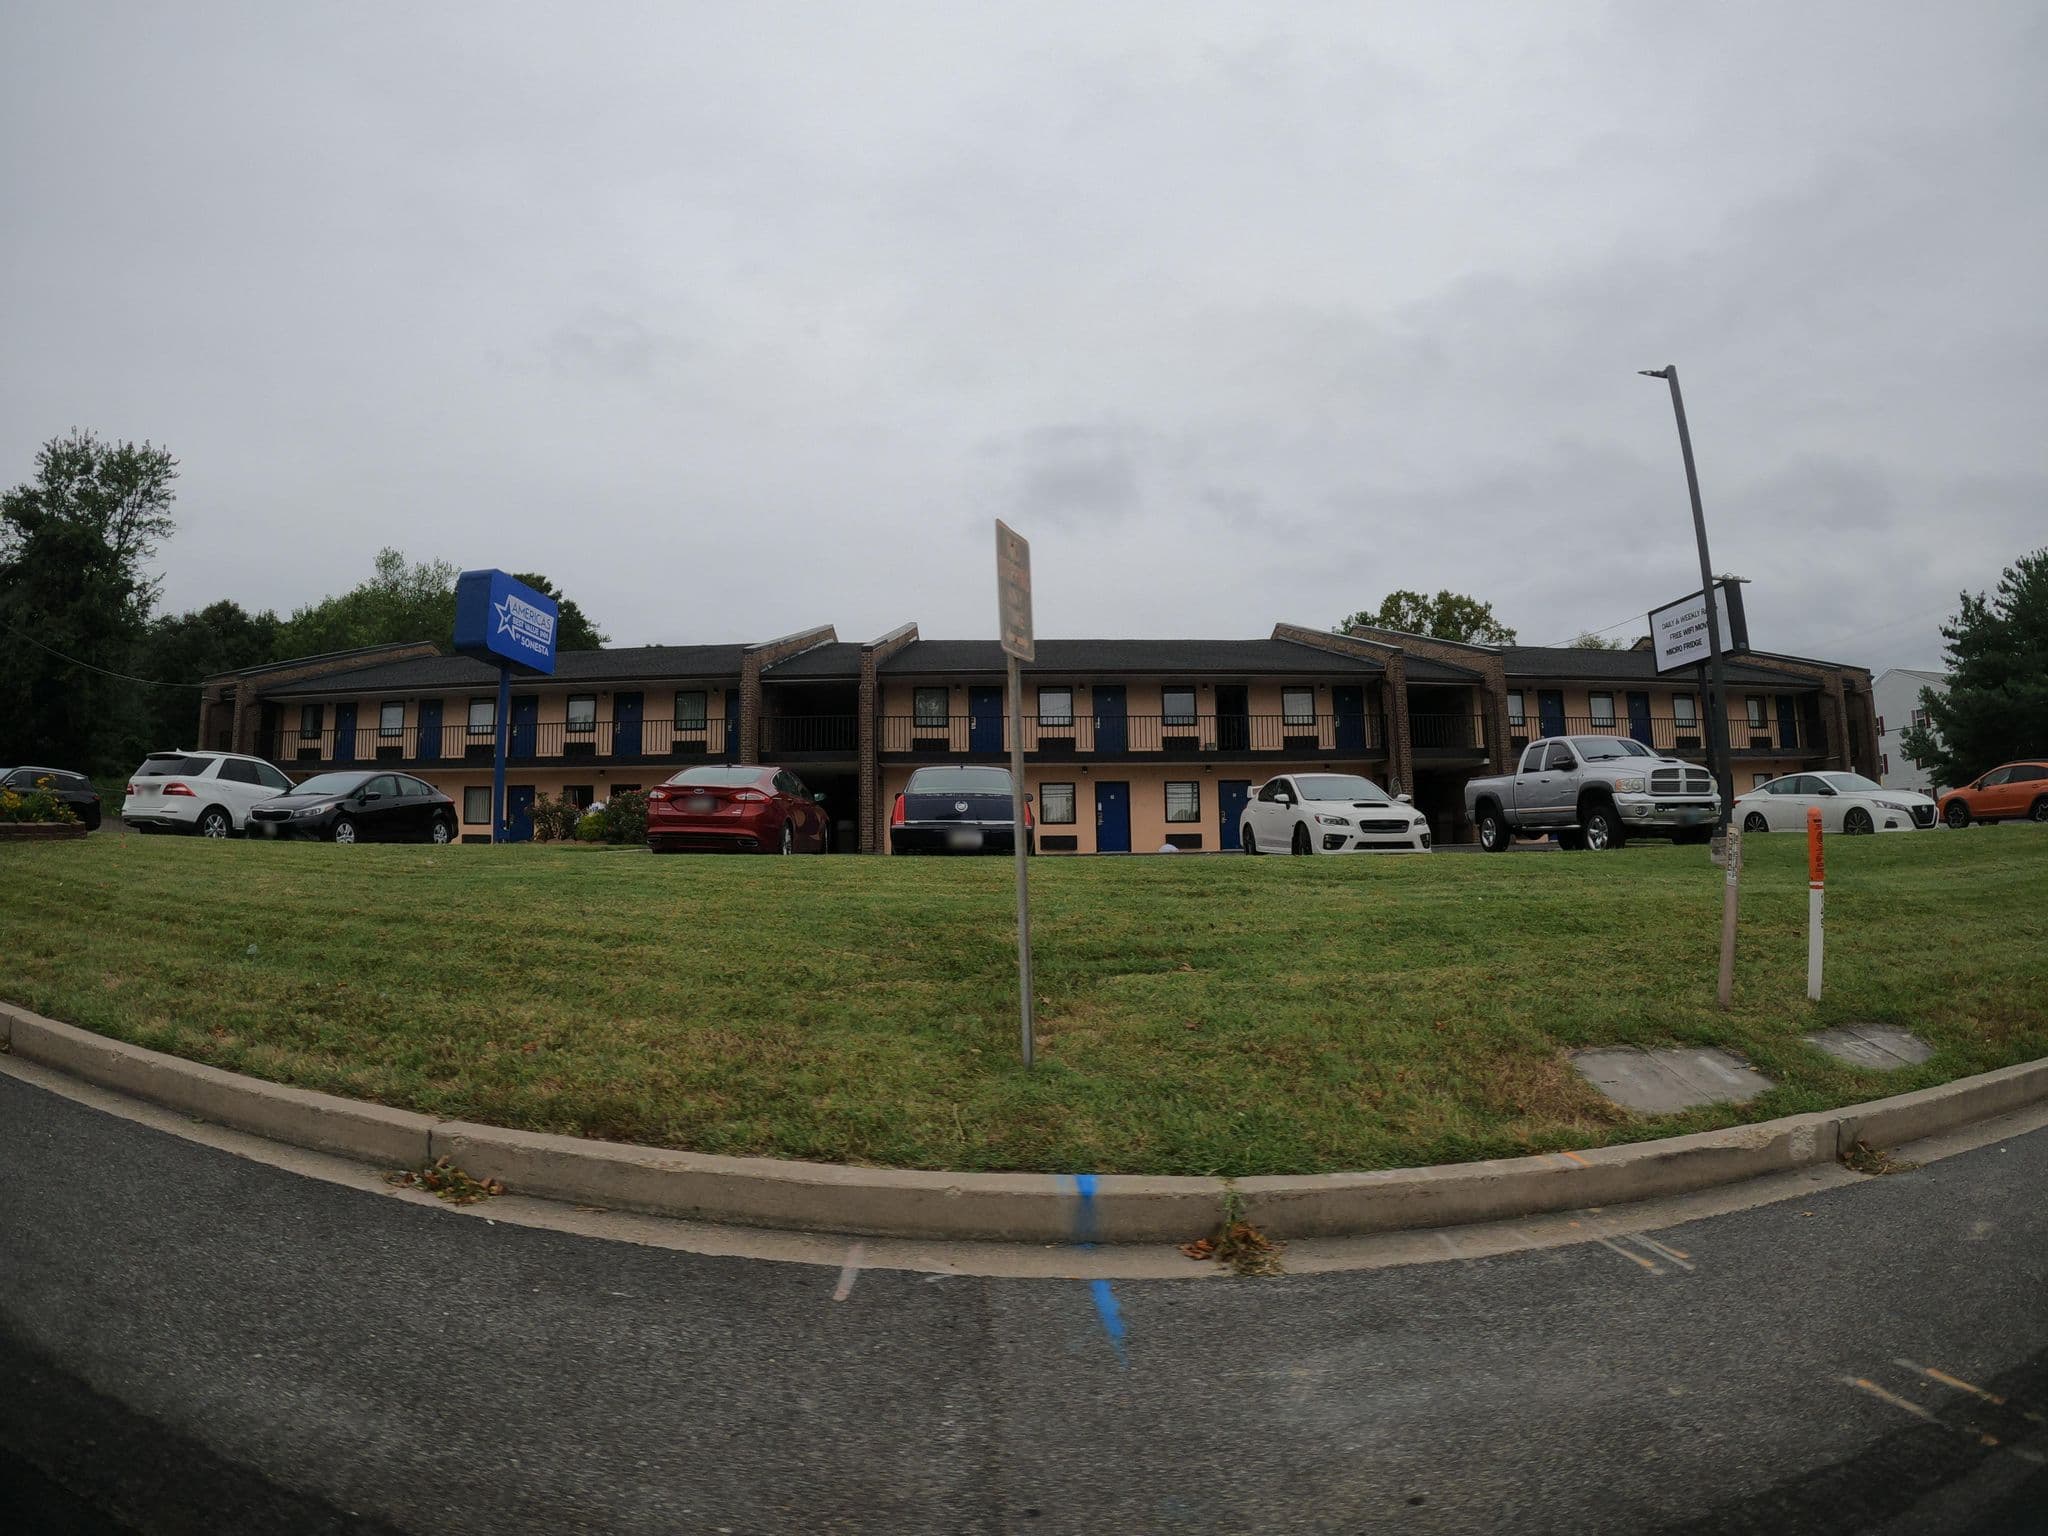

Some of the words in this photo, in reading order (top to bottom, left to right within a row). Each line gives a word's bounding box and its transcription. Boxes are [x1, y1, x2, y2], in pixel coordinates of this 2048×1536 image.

[512, 603, 551, 629] AMERICAS
[1661, 619, 1675, 630] DAILY
[1680, 610, 1700, 623] WEEKLY
[1669, 630, 1683, 640] FREE
[521, 636, 548, 656] SONESTA
[1666, 645, 1682, 656] MICRO
[1683, 638, 1702, 651] FRIDGE
